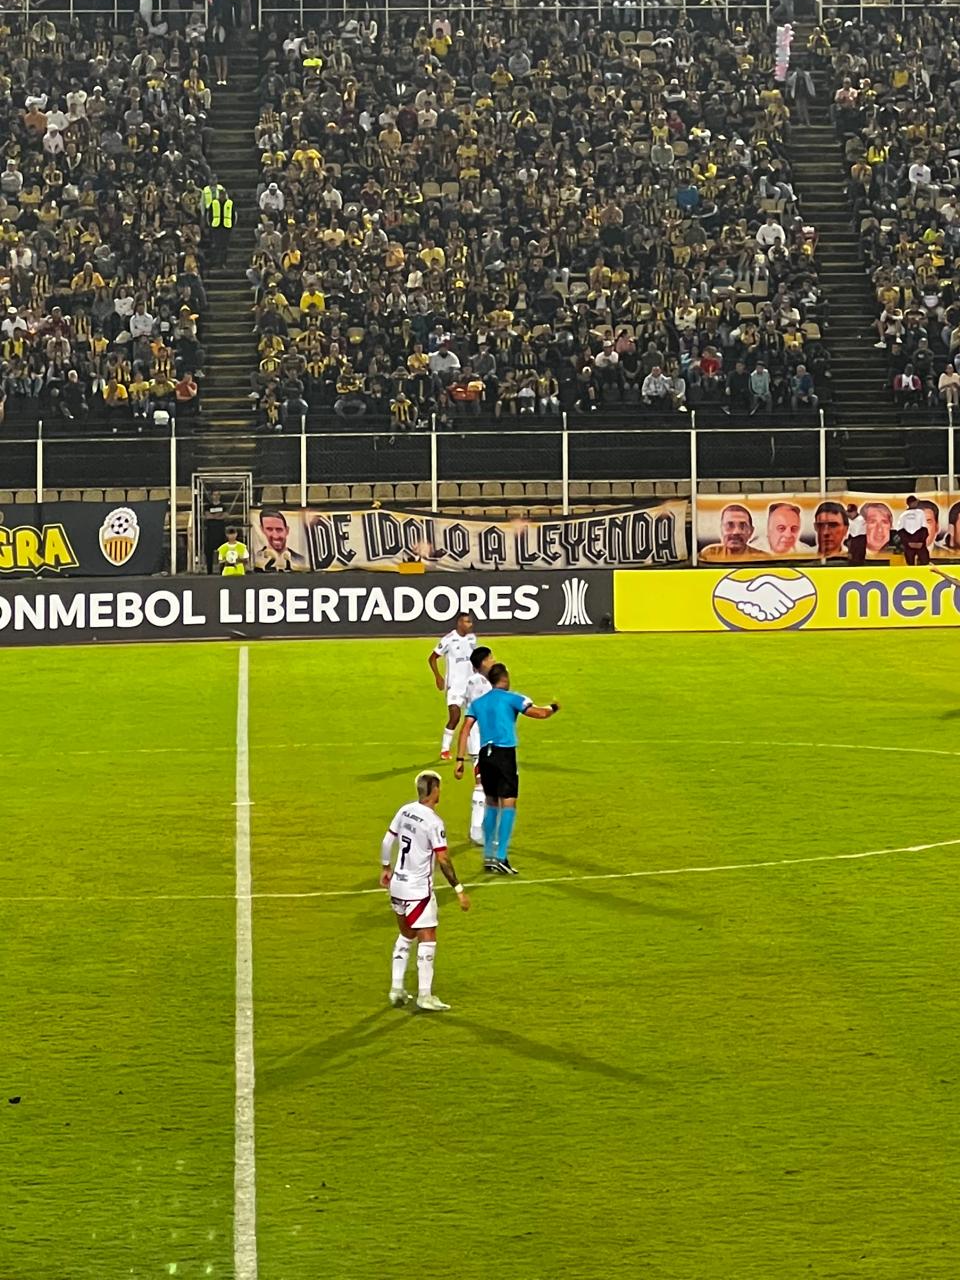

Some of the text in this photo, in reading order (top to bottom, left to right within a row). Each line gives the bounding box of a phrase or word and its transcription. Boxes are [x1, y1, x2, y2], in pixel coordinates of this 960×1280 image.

[305, 511, 679, 571] DE IDOLO A LEYENDA
[219, 584, 539, 624] LIBERTADORES
[400, 835, 412, 870] 7
